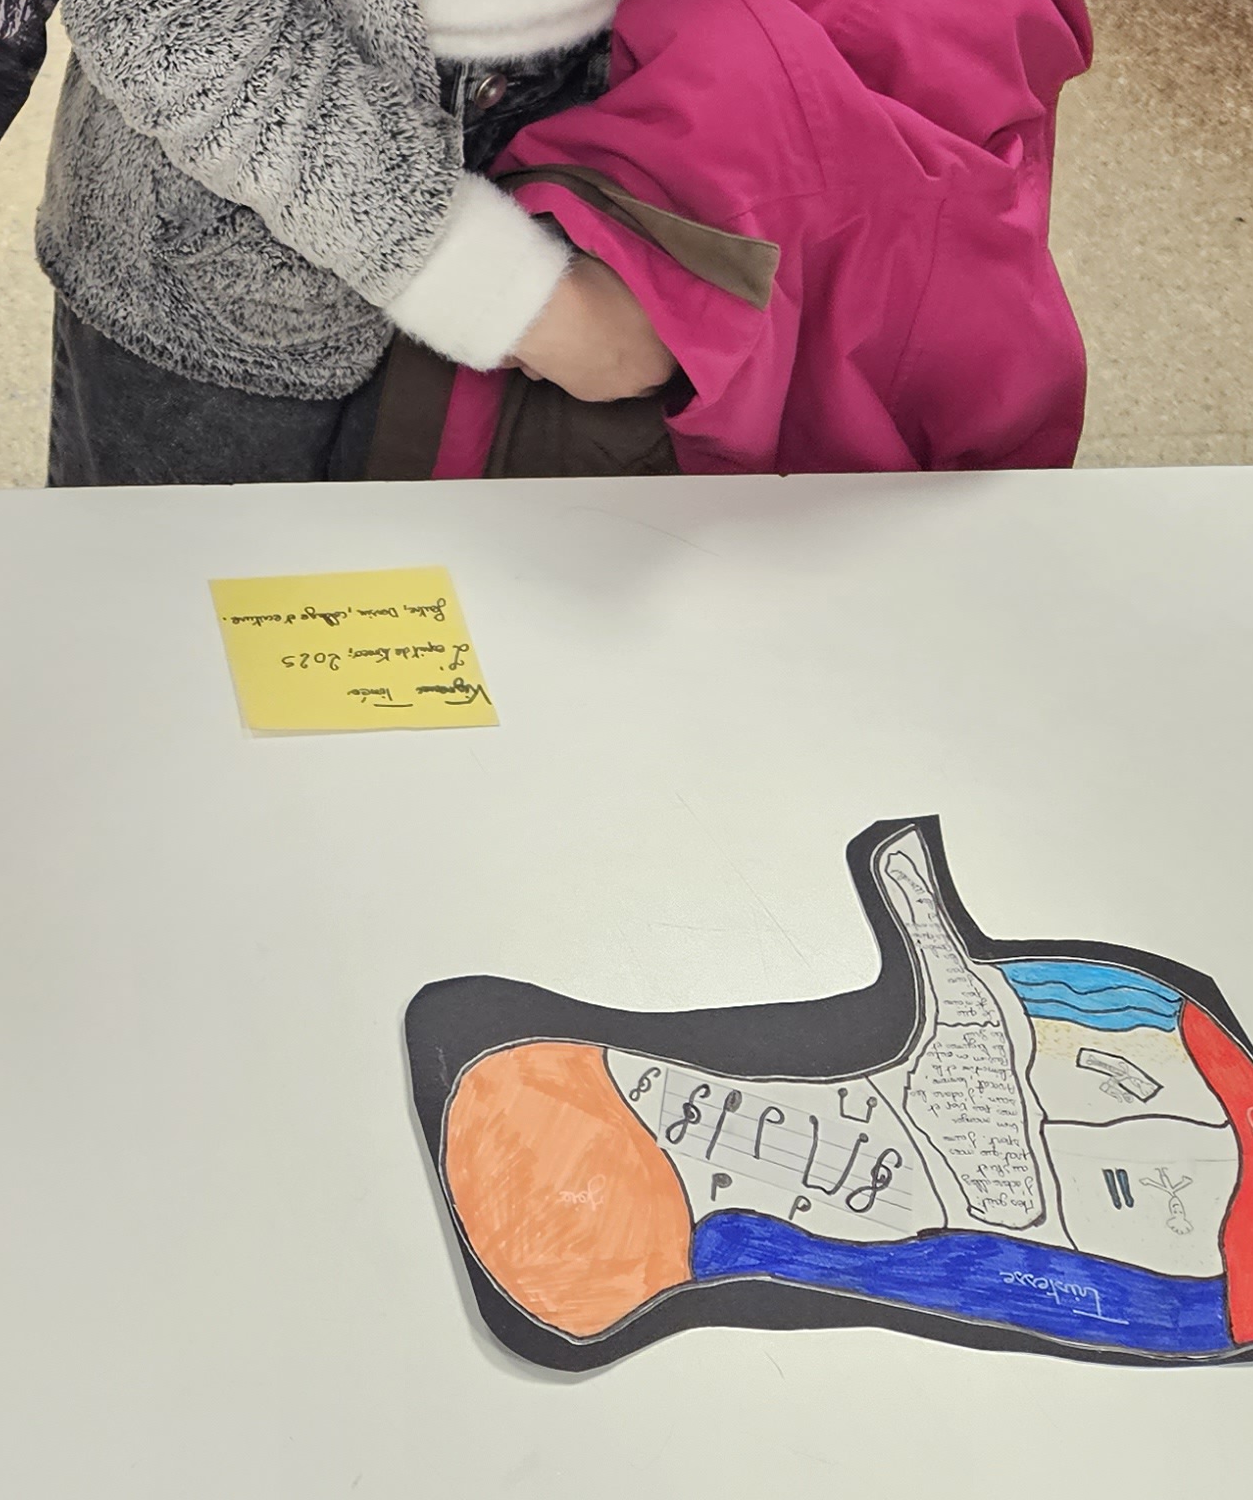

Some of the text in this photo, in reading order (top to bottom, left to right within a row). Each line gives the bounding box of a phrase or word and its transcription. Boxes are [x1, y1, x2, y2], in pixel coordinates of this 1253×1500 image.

[282, 612, 296, 626] et
[280, 651, 342, 672] 2025
[394, 646, 411, 661] de
[999, 1270, 1130, 1326] Tristesse
